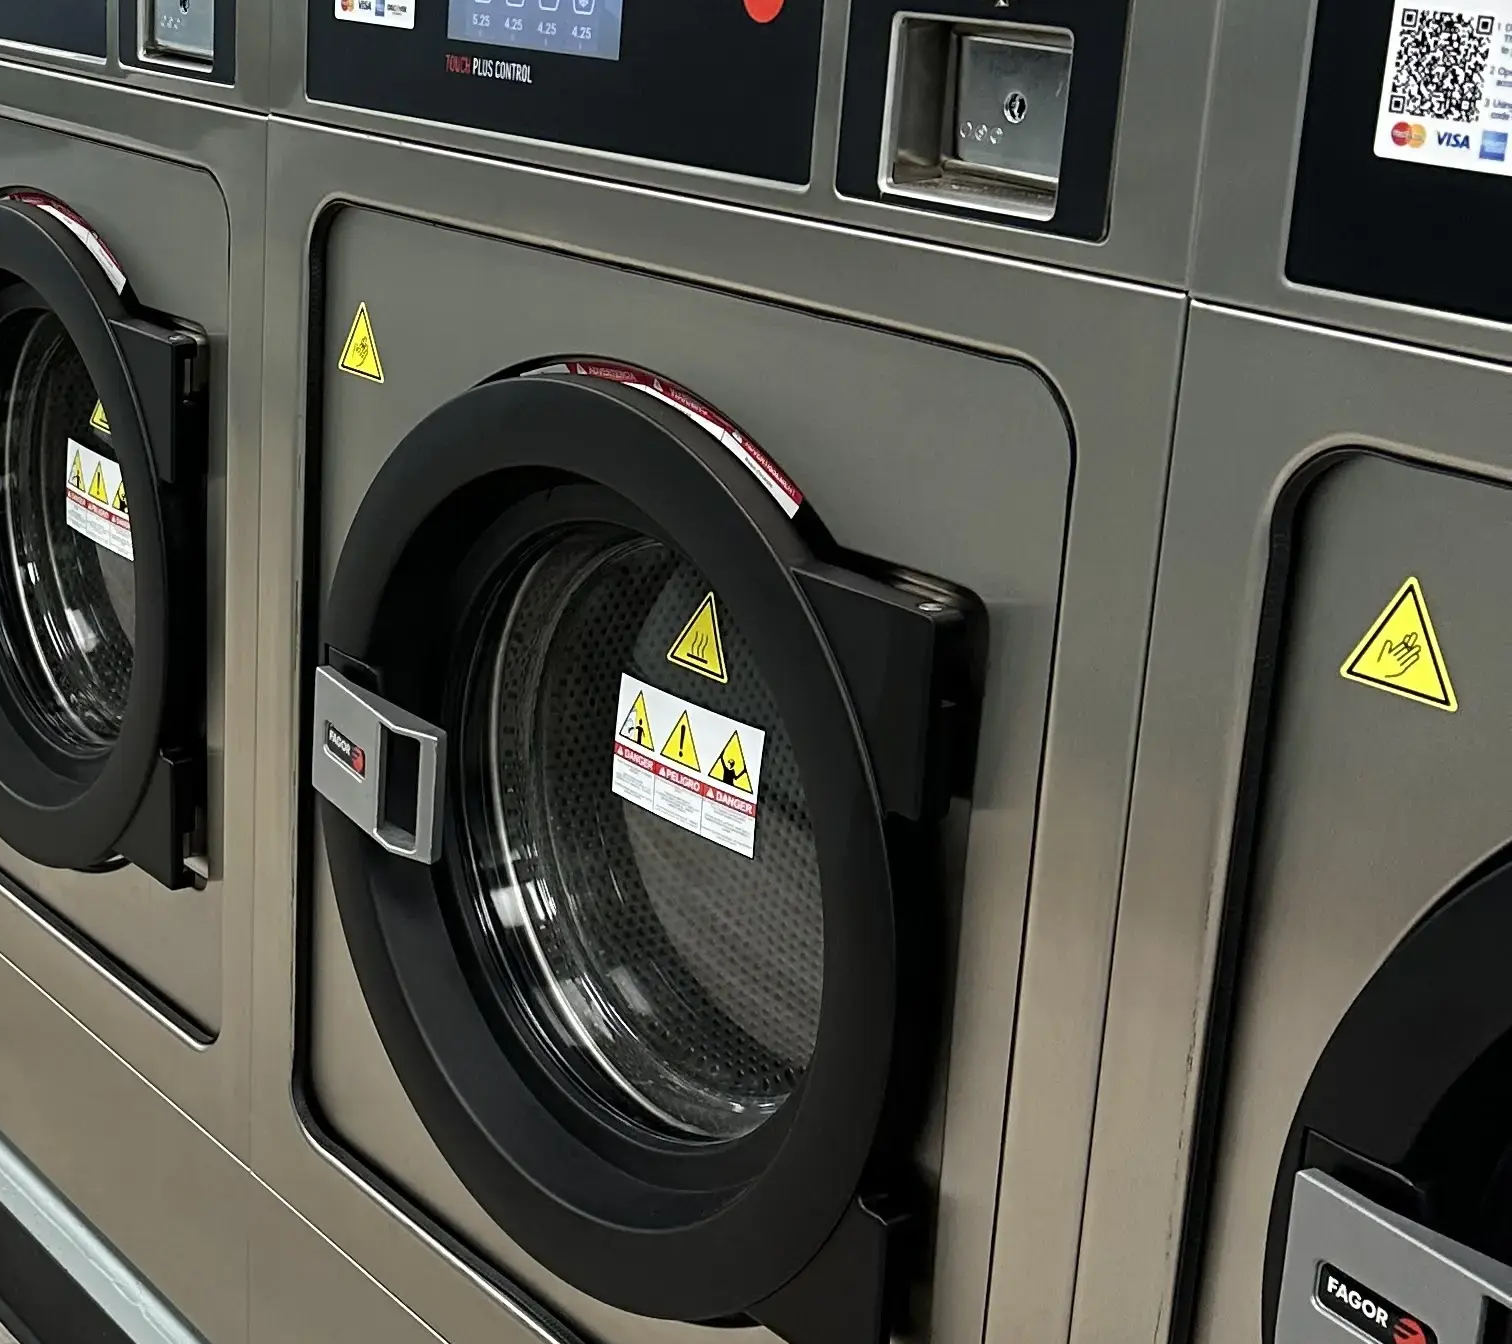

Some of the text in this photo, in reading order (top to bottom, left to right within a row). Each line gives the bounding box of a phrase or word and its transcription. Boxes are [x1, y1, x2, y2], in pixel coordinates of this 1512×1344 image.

[504, 17, 523, 32] 4.25
[537, 21, 557, 35] 4.25
[571, 25, 592, 40] 4.25
[445, 54, 533, 84] TOUCH PLUS CONTROL
[1436, 131, 1471, 150] VISA
[624, 748, 654, 772] DANGER
[666, 767, 701, 793] PELIGRO
[716, 791, 754, 815] DANGER
[1327, 1275, 1389, 1329] FAGOR
